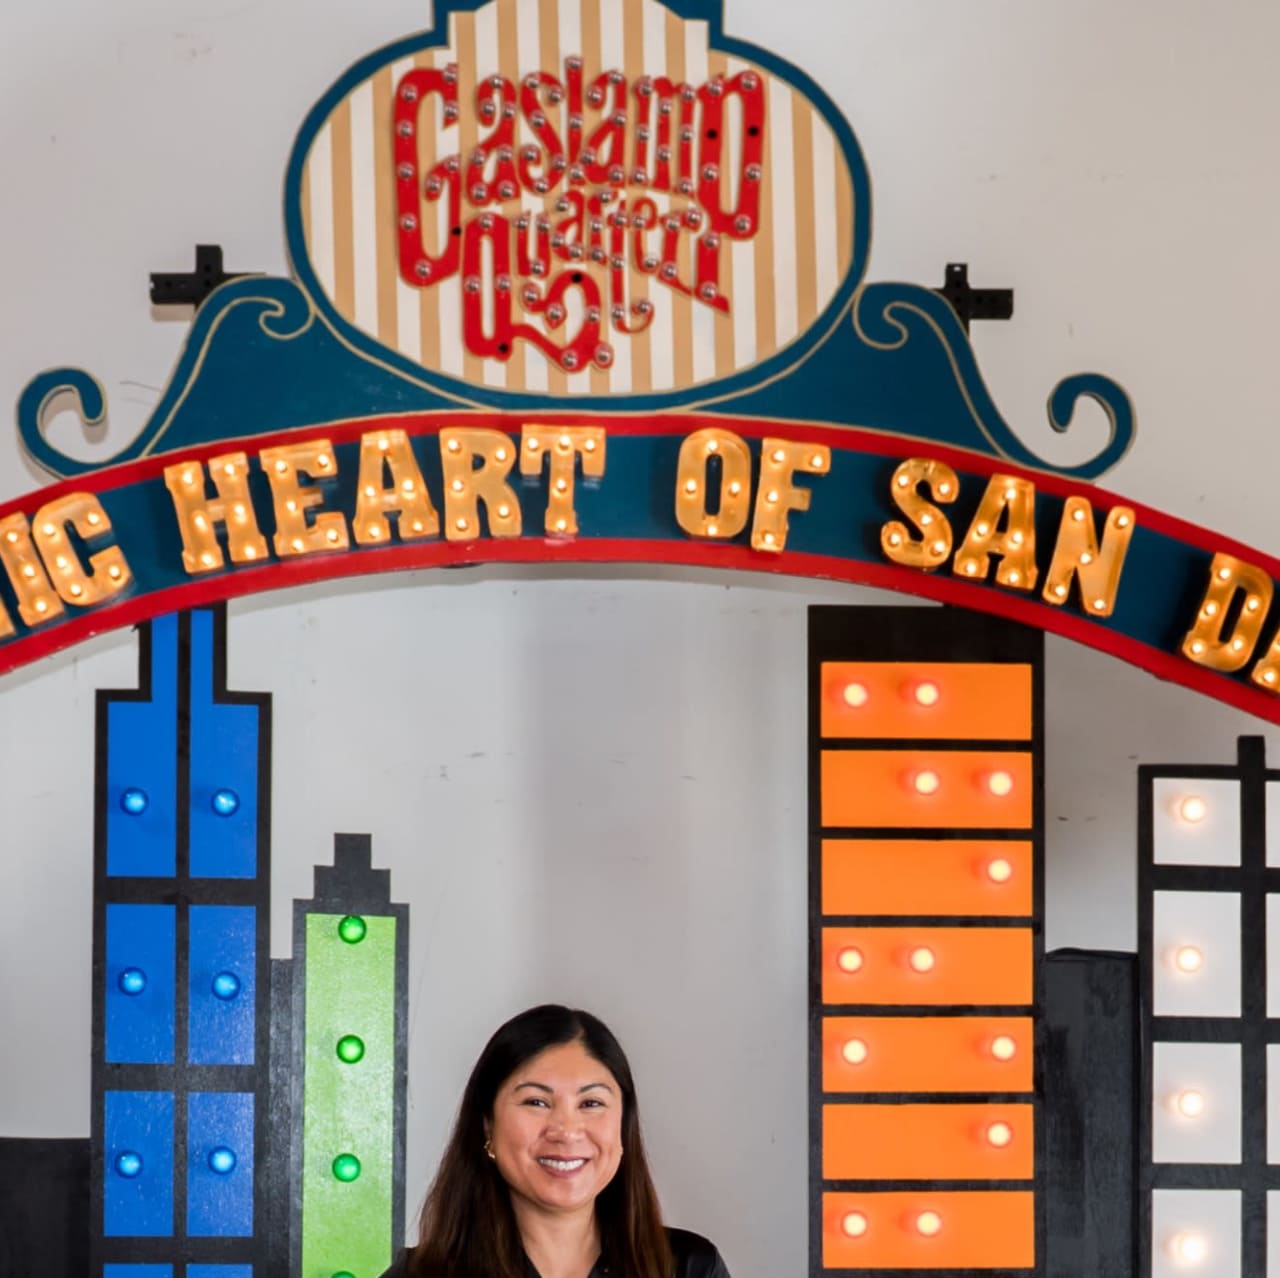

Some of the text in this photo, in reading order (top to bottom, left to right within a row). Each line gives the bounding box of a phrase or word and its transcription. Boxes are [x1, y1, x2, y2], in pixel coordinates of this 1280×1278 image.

[393, 55, 765, 316] Gaslamp
[463, 187, 706, 373] Quarter
[164, 423, 605, 574] HEART
[674, 427, 831, 553] OF
[880, 457, 1137, 617] SAN
